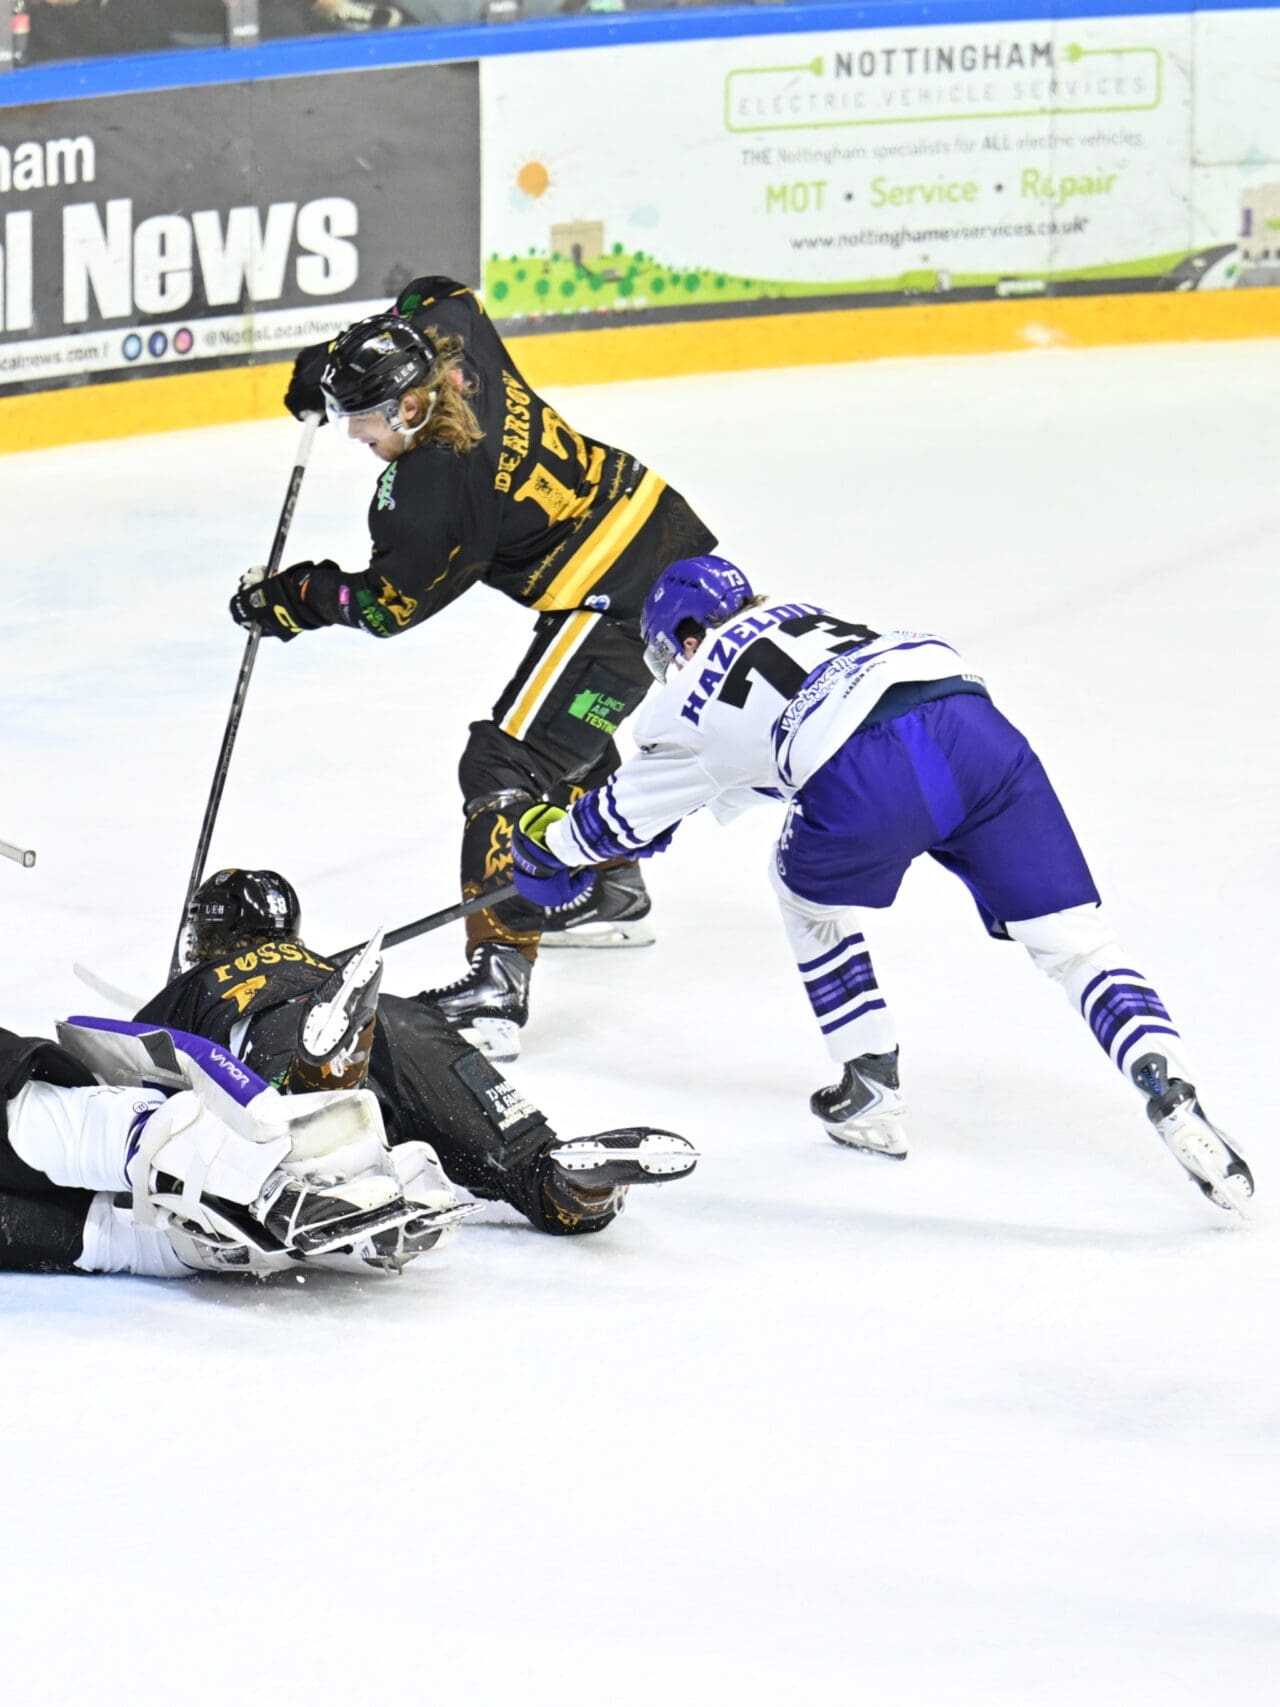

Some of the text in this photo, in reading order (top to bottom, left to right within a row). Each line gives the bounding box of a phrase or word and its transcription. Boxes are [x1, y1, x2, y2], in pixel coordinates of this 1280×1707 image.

[835, 41, 1054, 78] NOTTINGHAM
[739, 76, 1145, 116] ELECTRIC VEHICLE SERVICES
[777, 145, 866, 165] Nottingham
[982, 134, 1010, 151] ALL
[765, 180, 829, 214] MOT
[870, 175, 980, 208] Service
[62, 196, 358, 323] News
[722, 569, 745, 587] 73
[717, 613, 882, 710] 73
[209, 1047, 250, 1089] VAPOR
